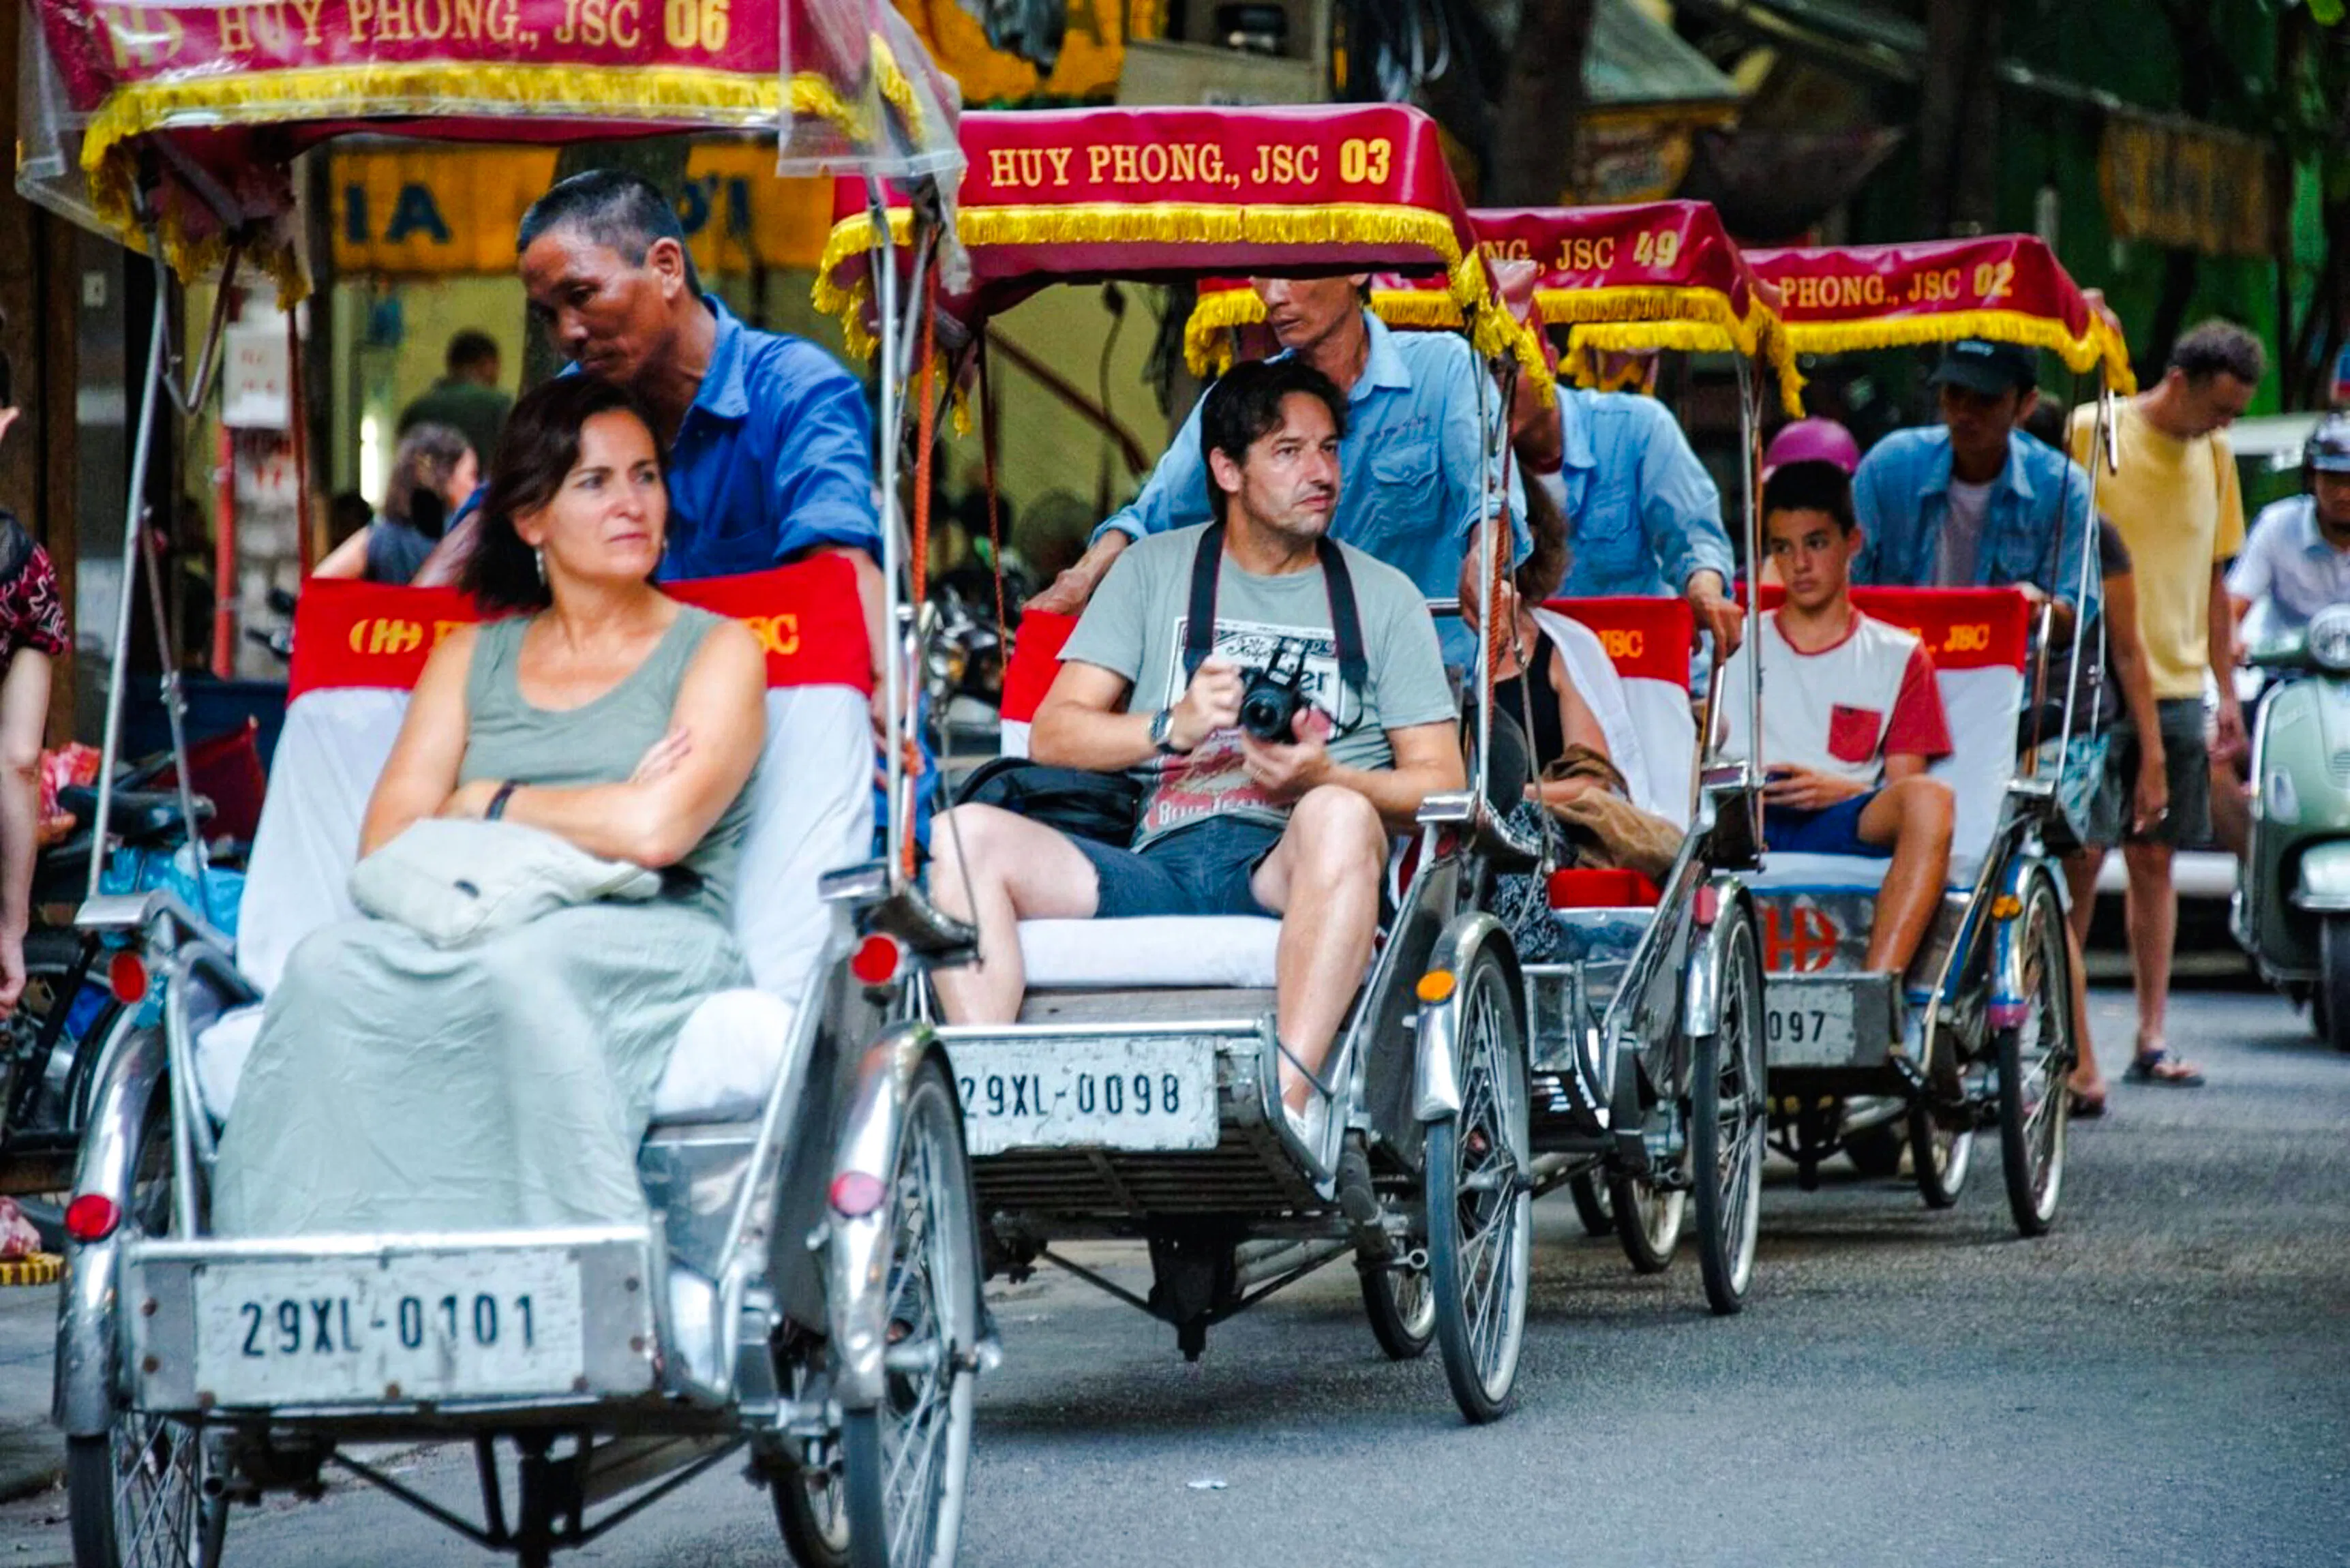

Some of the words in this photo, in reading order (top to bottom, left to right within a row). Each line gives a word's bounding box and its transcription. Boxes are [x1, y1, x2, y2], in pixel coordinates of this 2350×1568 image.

[217, 0, 323, 52] HUY
[555, 0, 641, 48] JSC
[663, 0, 729, 52] 06
[989, 148, 1072, 187] HUY
[1087, 144, 1240, 190] PHONG.,
[1252, 145, 1319, 184] JSC
[1340, 138, 1391, 184] 03
[1556, 237, 1615, 271] JSC
[1633, 230, 1679, 269] 49
[1908, 269, 1961, 302] JSC
[1974, 261, 2015, 297] 02
[960, 1072, 1180, 1118] 29XL-0098
[240, 1293, 536, 1357] 29XL-0101
